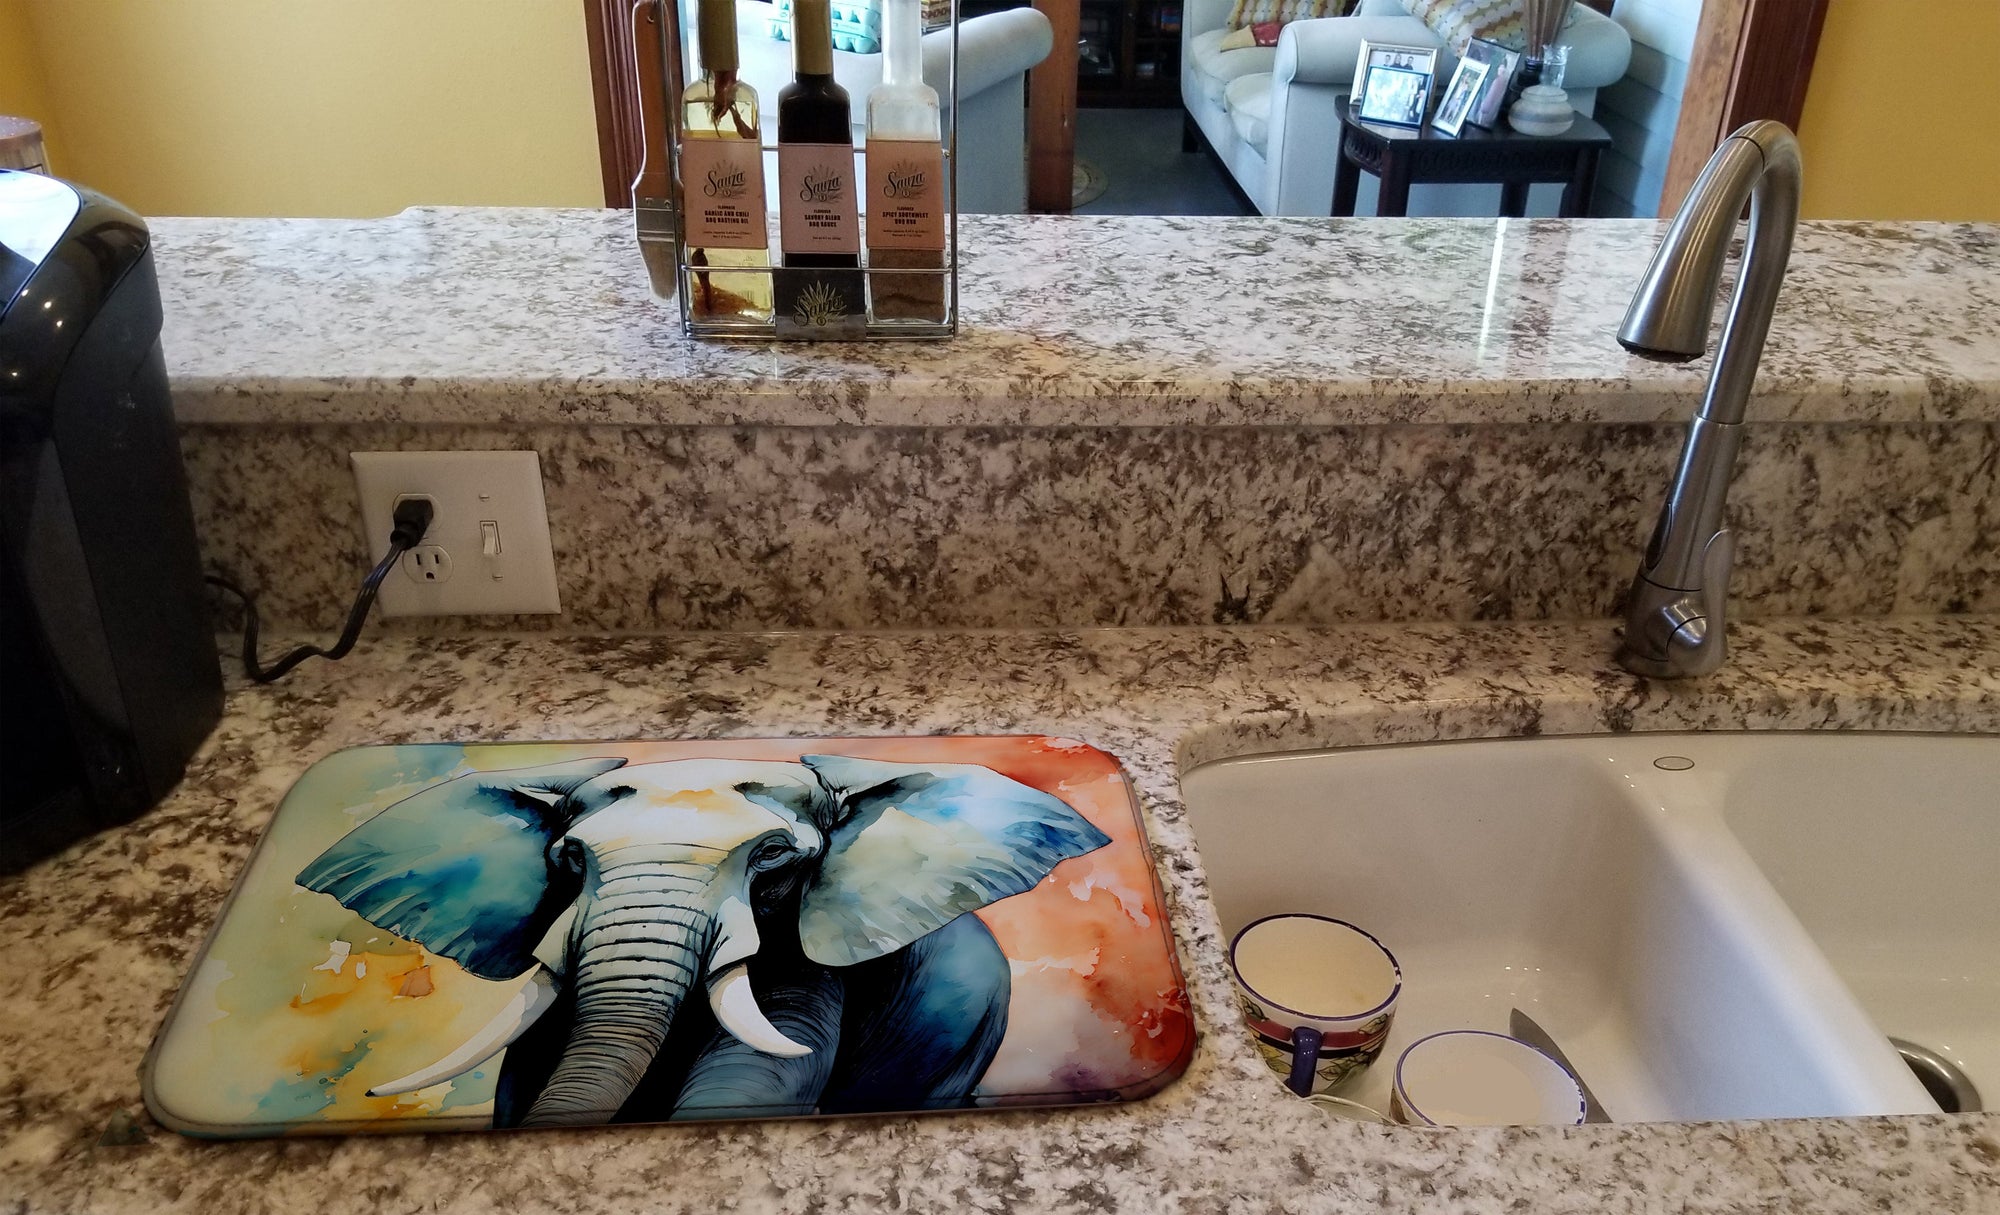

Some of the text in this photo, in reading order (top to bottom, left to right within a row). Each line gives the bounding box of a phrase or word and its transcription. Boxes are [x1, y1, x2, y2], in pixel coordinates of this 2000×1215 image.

[704, 170, 746, 197] Sauza
[800, 175, 842, 202] Sauza
[883, 171, 926, 198] Sauza
[898, 211, 929, 219] SOUTHWEST
